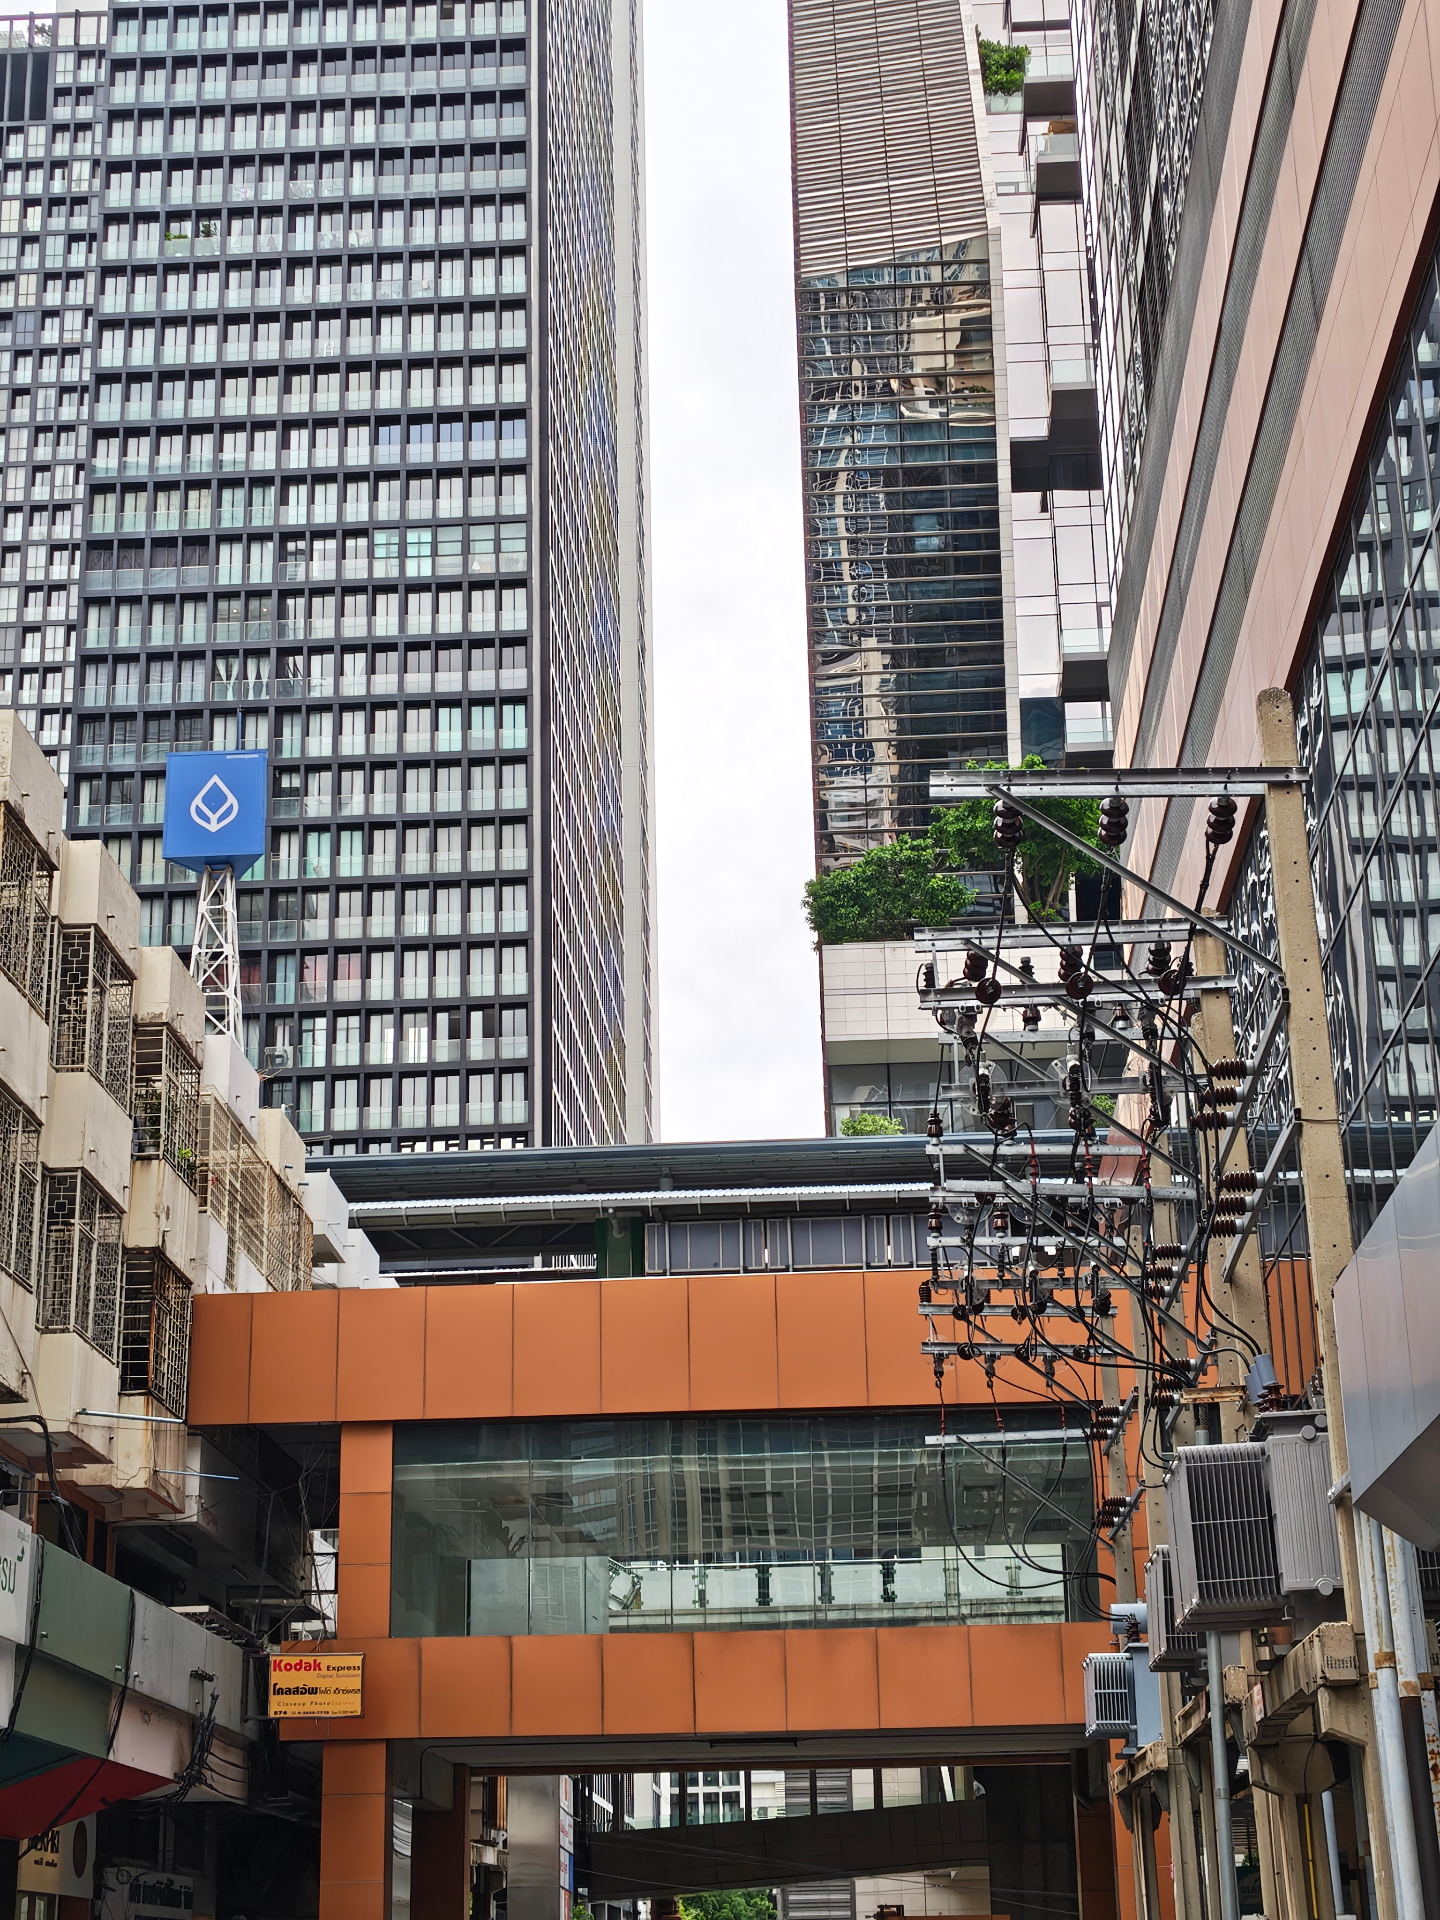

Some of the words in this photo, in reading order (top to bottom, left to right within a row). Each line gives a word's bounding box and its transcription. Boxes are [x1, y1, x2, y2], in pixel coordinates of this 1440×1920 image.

[272, 1659, 322, 1672] Kodak
[326, 1664, 361, 1672] Express
[1240, 1885, 1260, 1894] SIA
